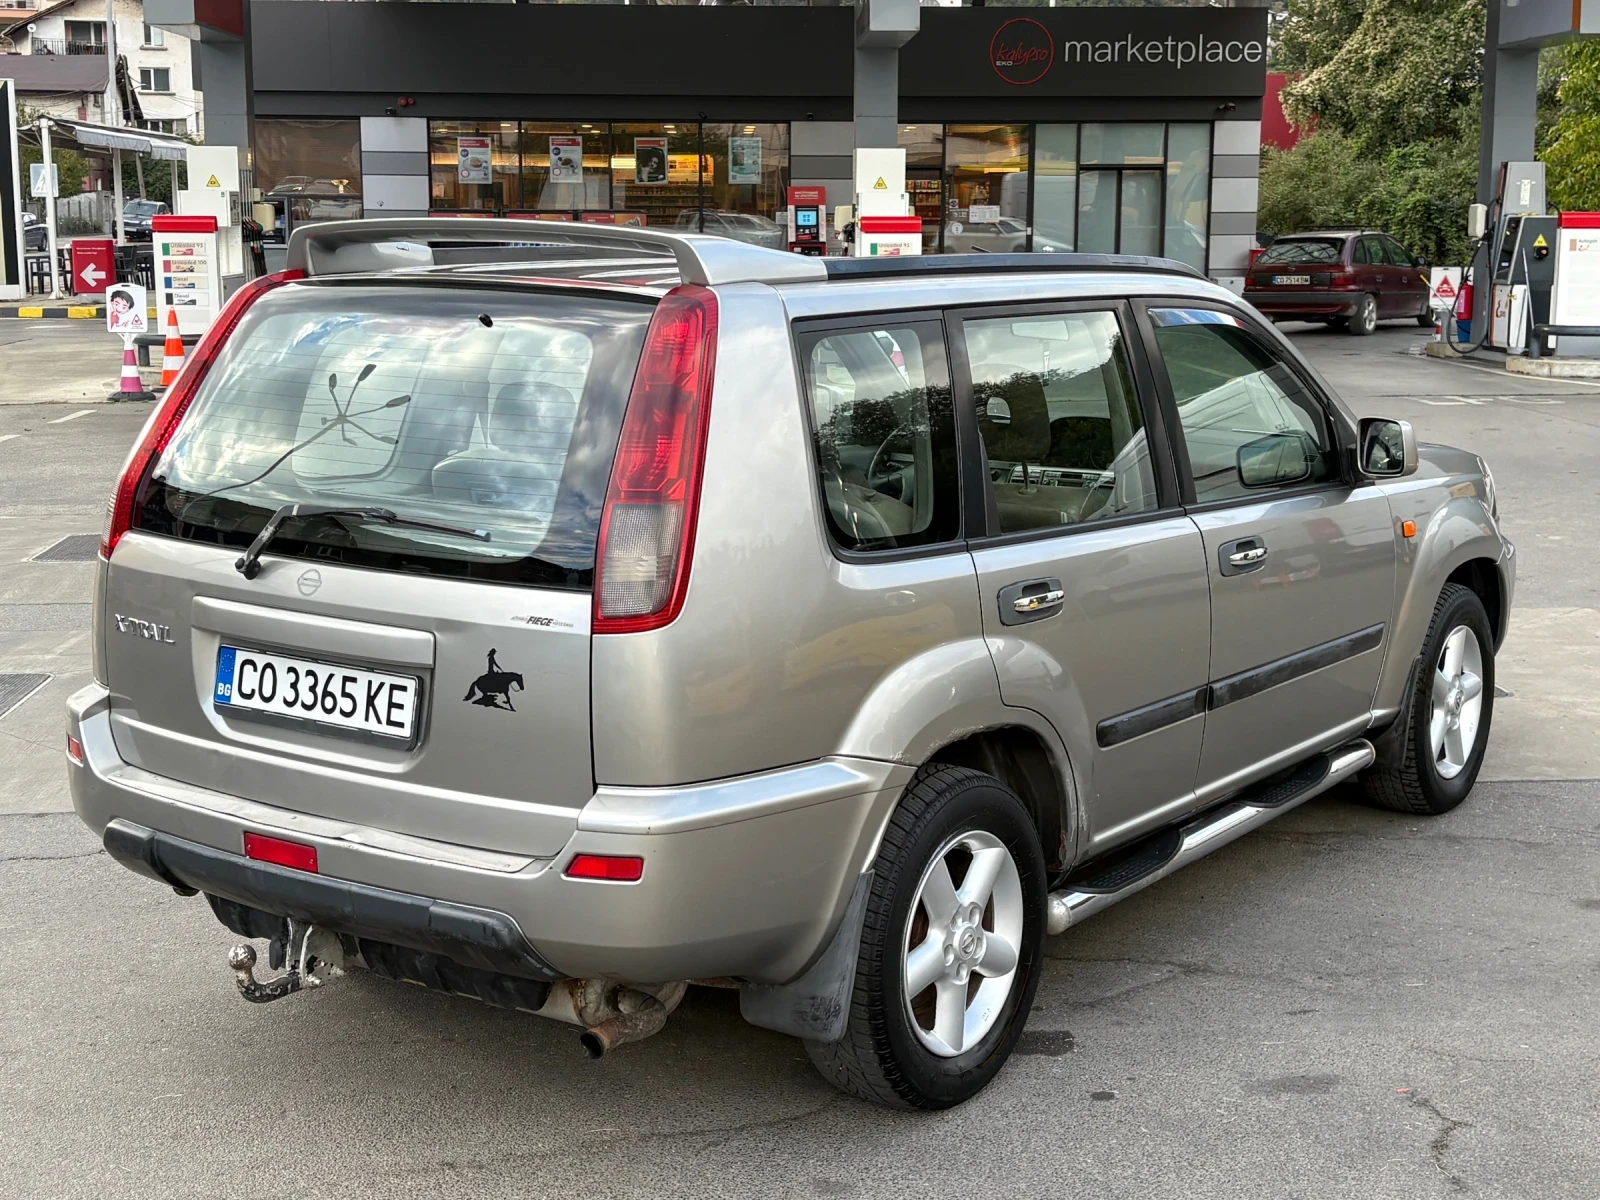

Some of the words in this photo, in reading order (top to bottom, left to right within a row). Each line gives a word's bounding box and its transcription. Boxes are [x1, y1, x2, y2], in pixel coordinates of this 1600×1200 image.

[996, 42, 1049, 66] kalypso
[1064, 33, 1263, 69] marketplace
[114, 613, 175, 644] X-TRAIL
[525, 615, 554, 627] FIEGE
[217, 682, 232, 697] BG
[237, 658, 278, 704] CO
[282, 666, 358, 719] 3365
[364, 678, 408, 729] KE
